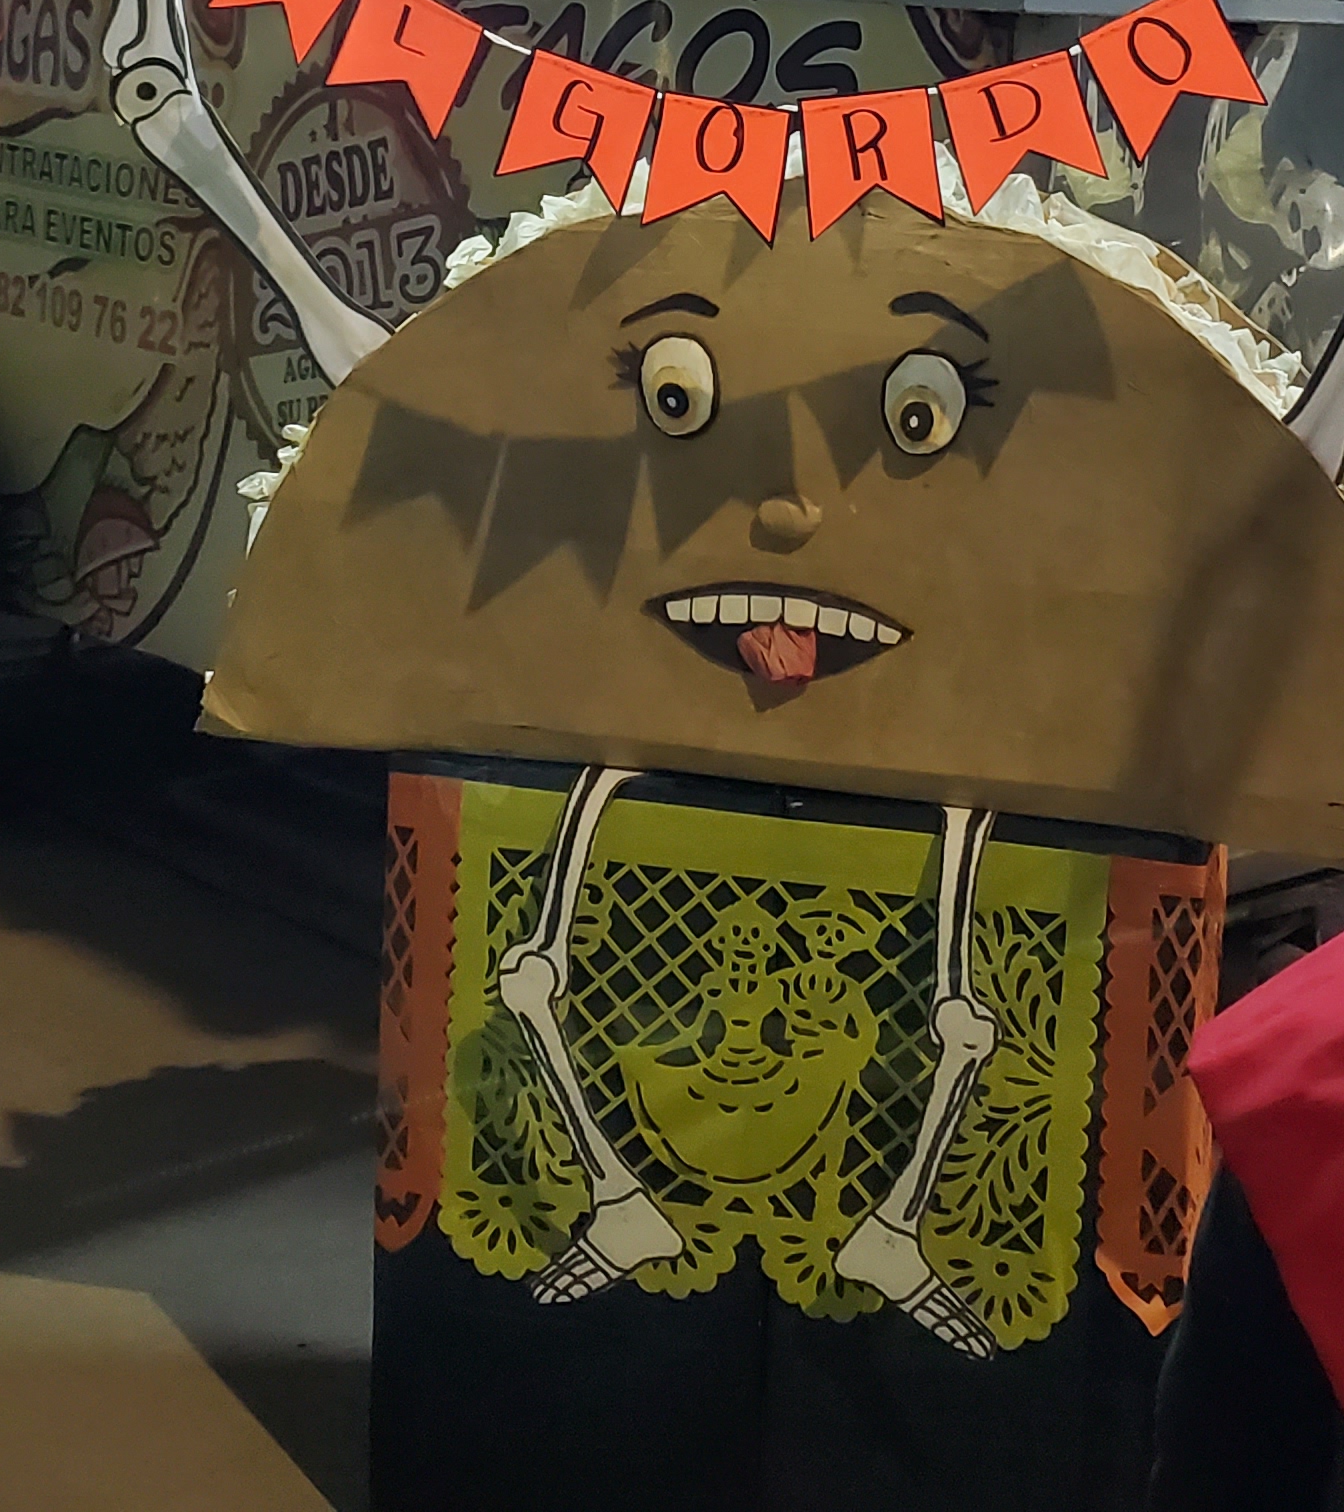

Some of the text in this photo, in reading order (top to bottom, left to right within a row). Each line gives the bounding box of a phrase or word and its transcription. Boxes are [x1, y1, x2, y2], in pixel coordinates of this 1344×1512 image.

[277, 136, 396, 224] DESDE
[45, 208, 177, 267] EVENTOS
[36, 278, 84, 333] 109
[93, 294, 128, 345] 76
[136, 305, 179, 357] 22
